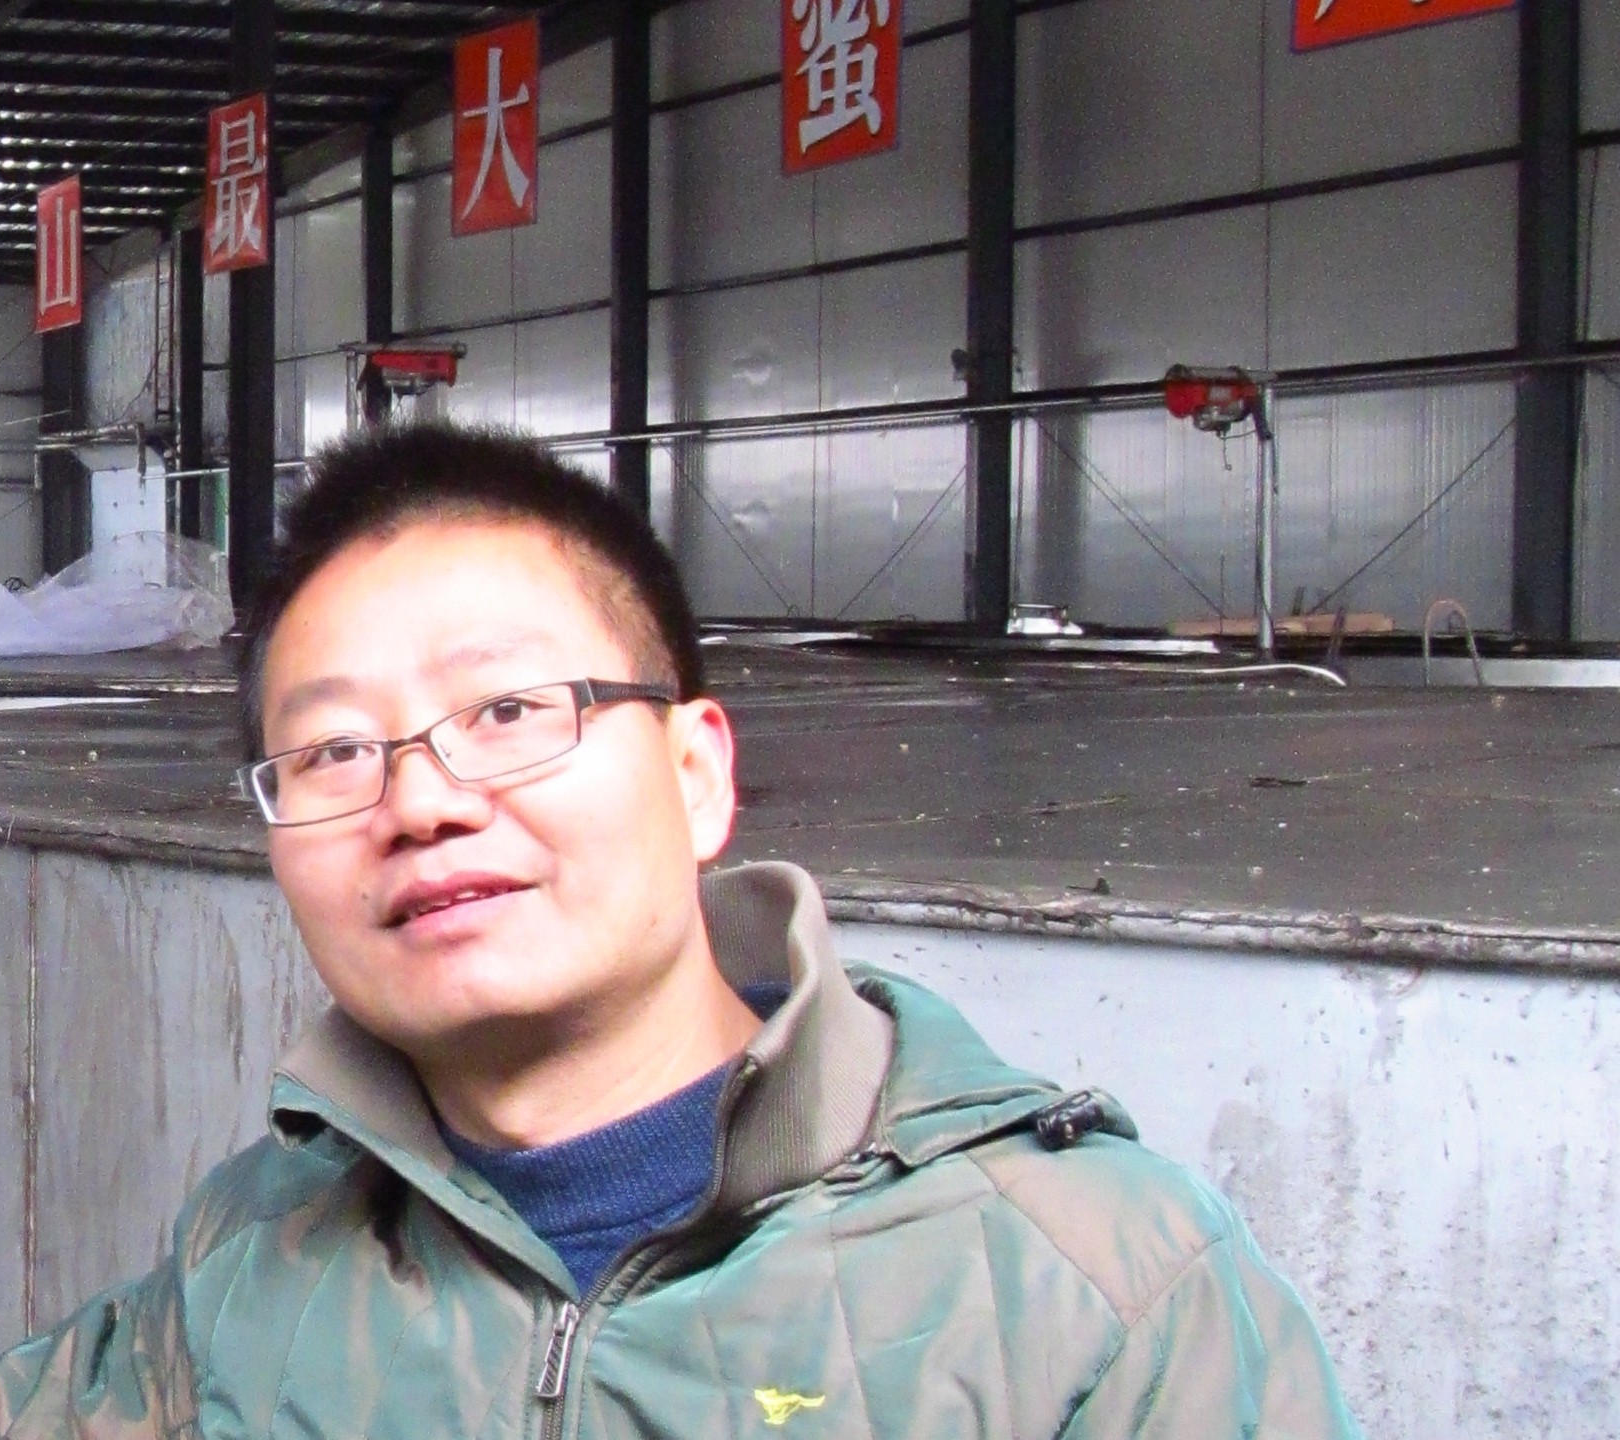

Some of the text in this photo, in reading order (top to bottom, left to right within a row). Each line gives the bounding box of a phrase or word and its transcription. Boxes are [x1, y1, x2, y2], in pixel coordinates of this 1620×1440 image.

[39, 195, 78, 313] 山
[211, 108, 263, 260] 最
[462, 47, 530, 222] 大
